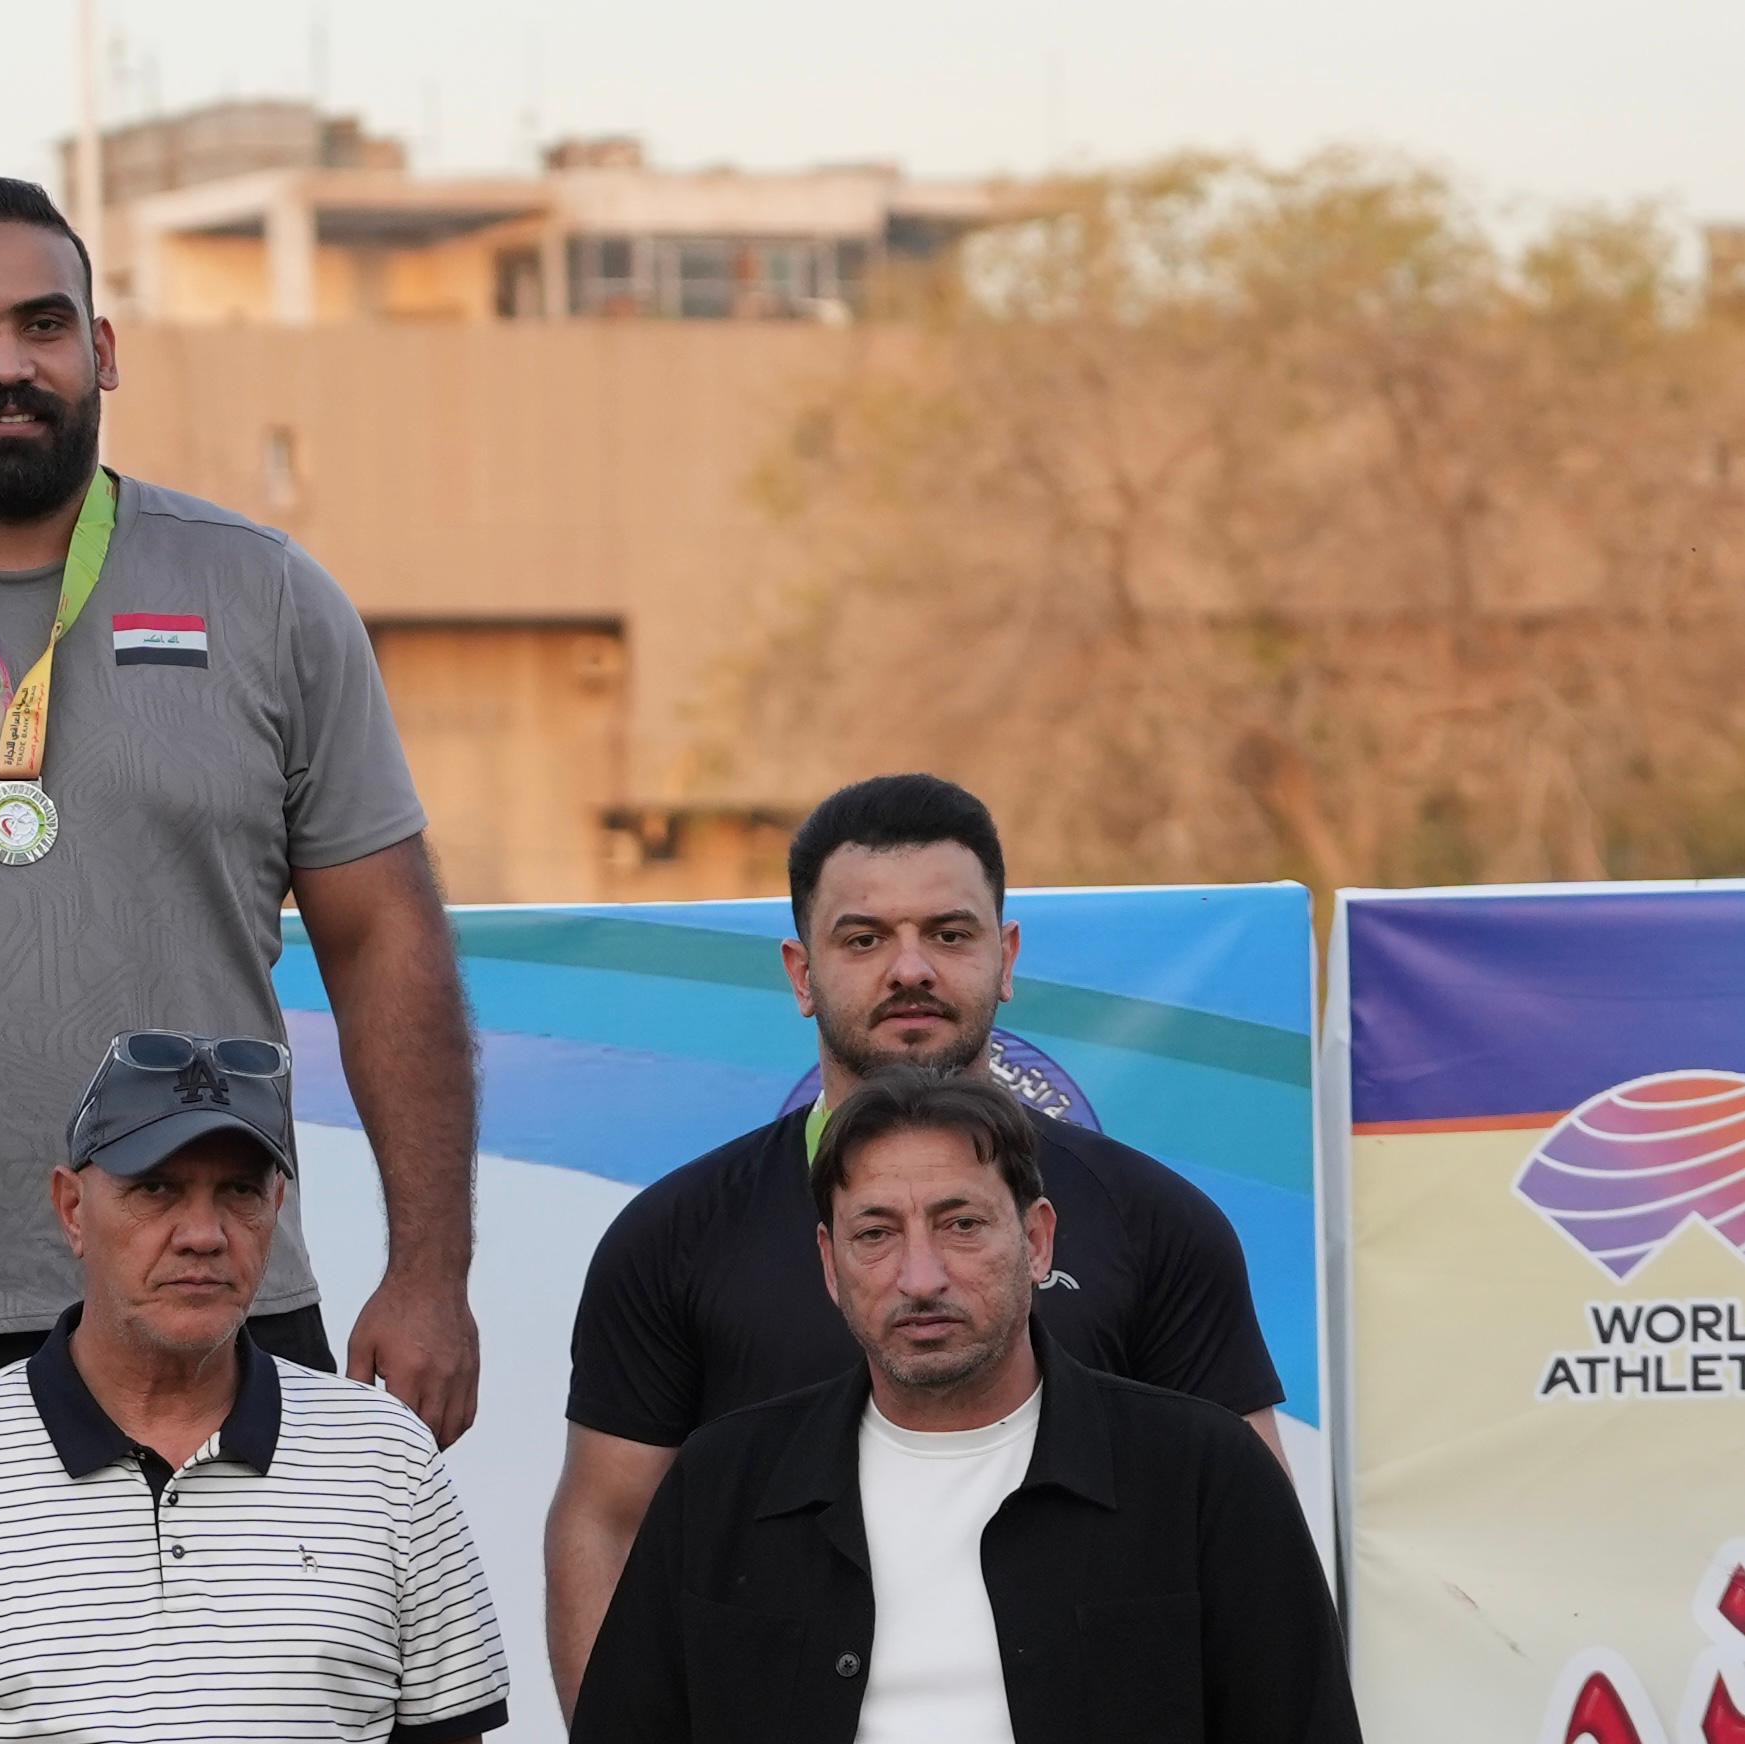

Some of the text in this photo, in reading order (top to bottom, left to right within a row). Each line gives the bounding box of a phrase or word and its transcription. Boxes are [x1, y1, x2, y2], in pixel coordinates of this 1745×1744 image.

[19, 716, 30, 739] BANK
[14, 739, 28, 767] TRADE
[1591, 1304, 1745, 1344] WORL
